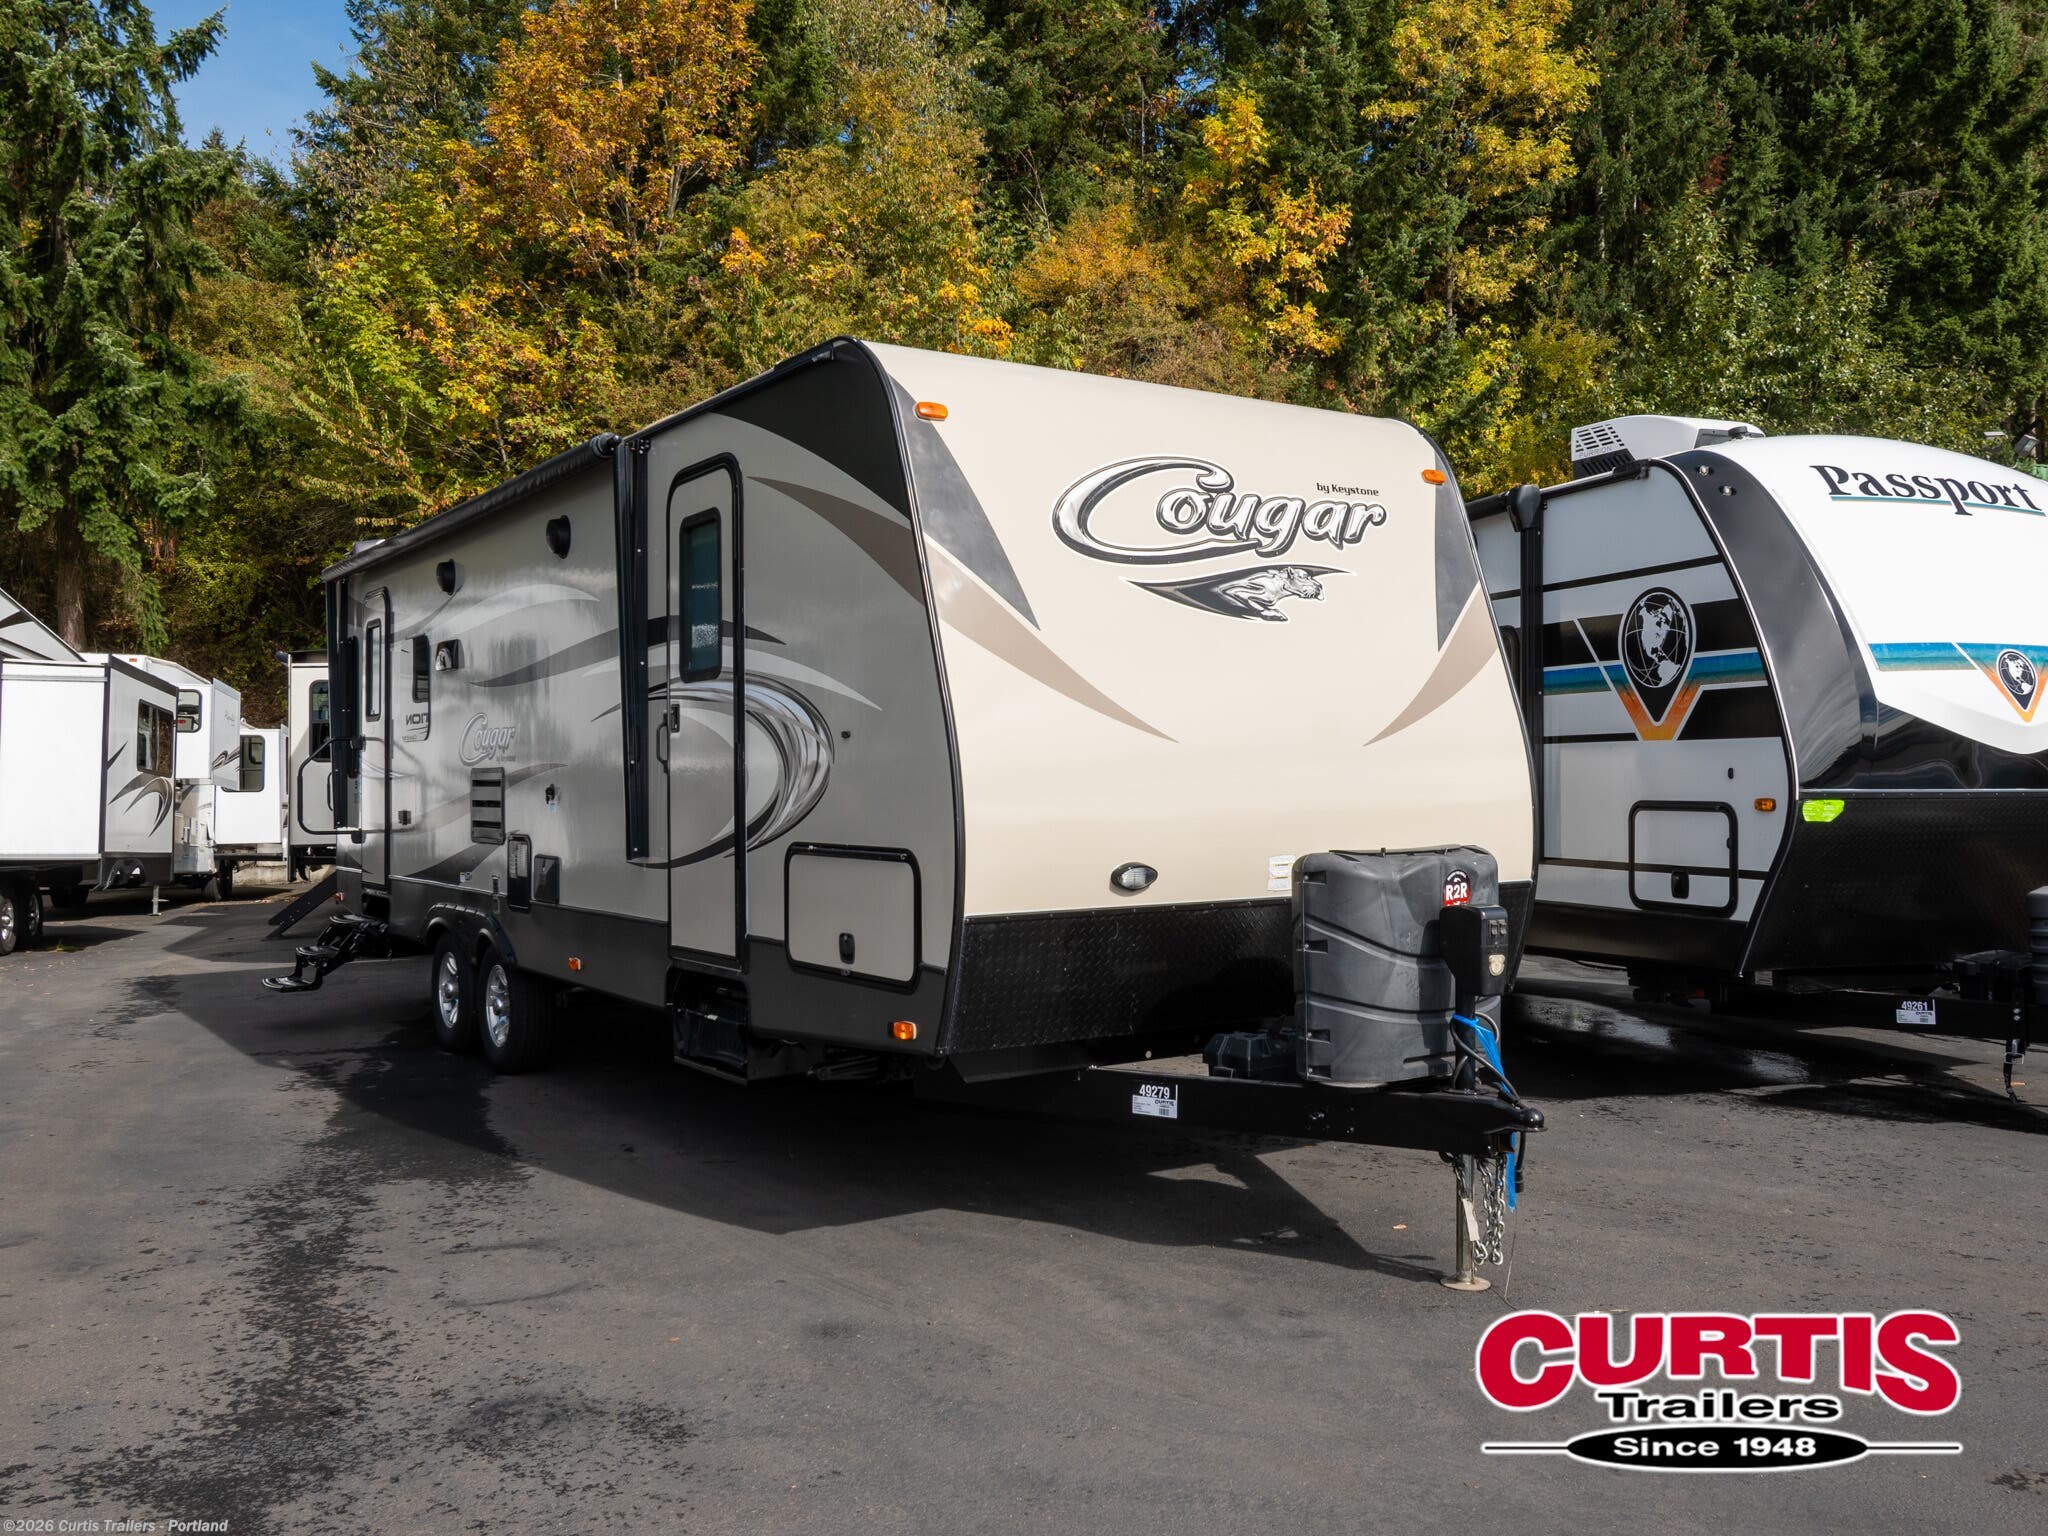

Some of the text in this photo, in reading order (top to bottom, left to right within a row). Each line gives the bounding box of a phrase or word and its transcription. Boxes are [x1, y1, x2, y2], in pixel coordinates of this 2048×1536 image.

[1316, 482, 1379, 497] by Keystone
[1808, 465, 2043, 516] Passport
[1052, 455, 1387, 565] Cougar
[458, 711, 516, 766] Cougar
[1445, 882, 1468, 901] R2R
[1901, 1000, 1928, 1011] 49261
[1139, 1084, 1170, 1099] 49279
